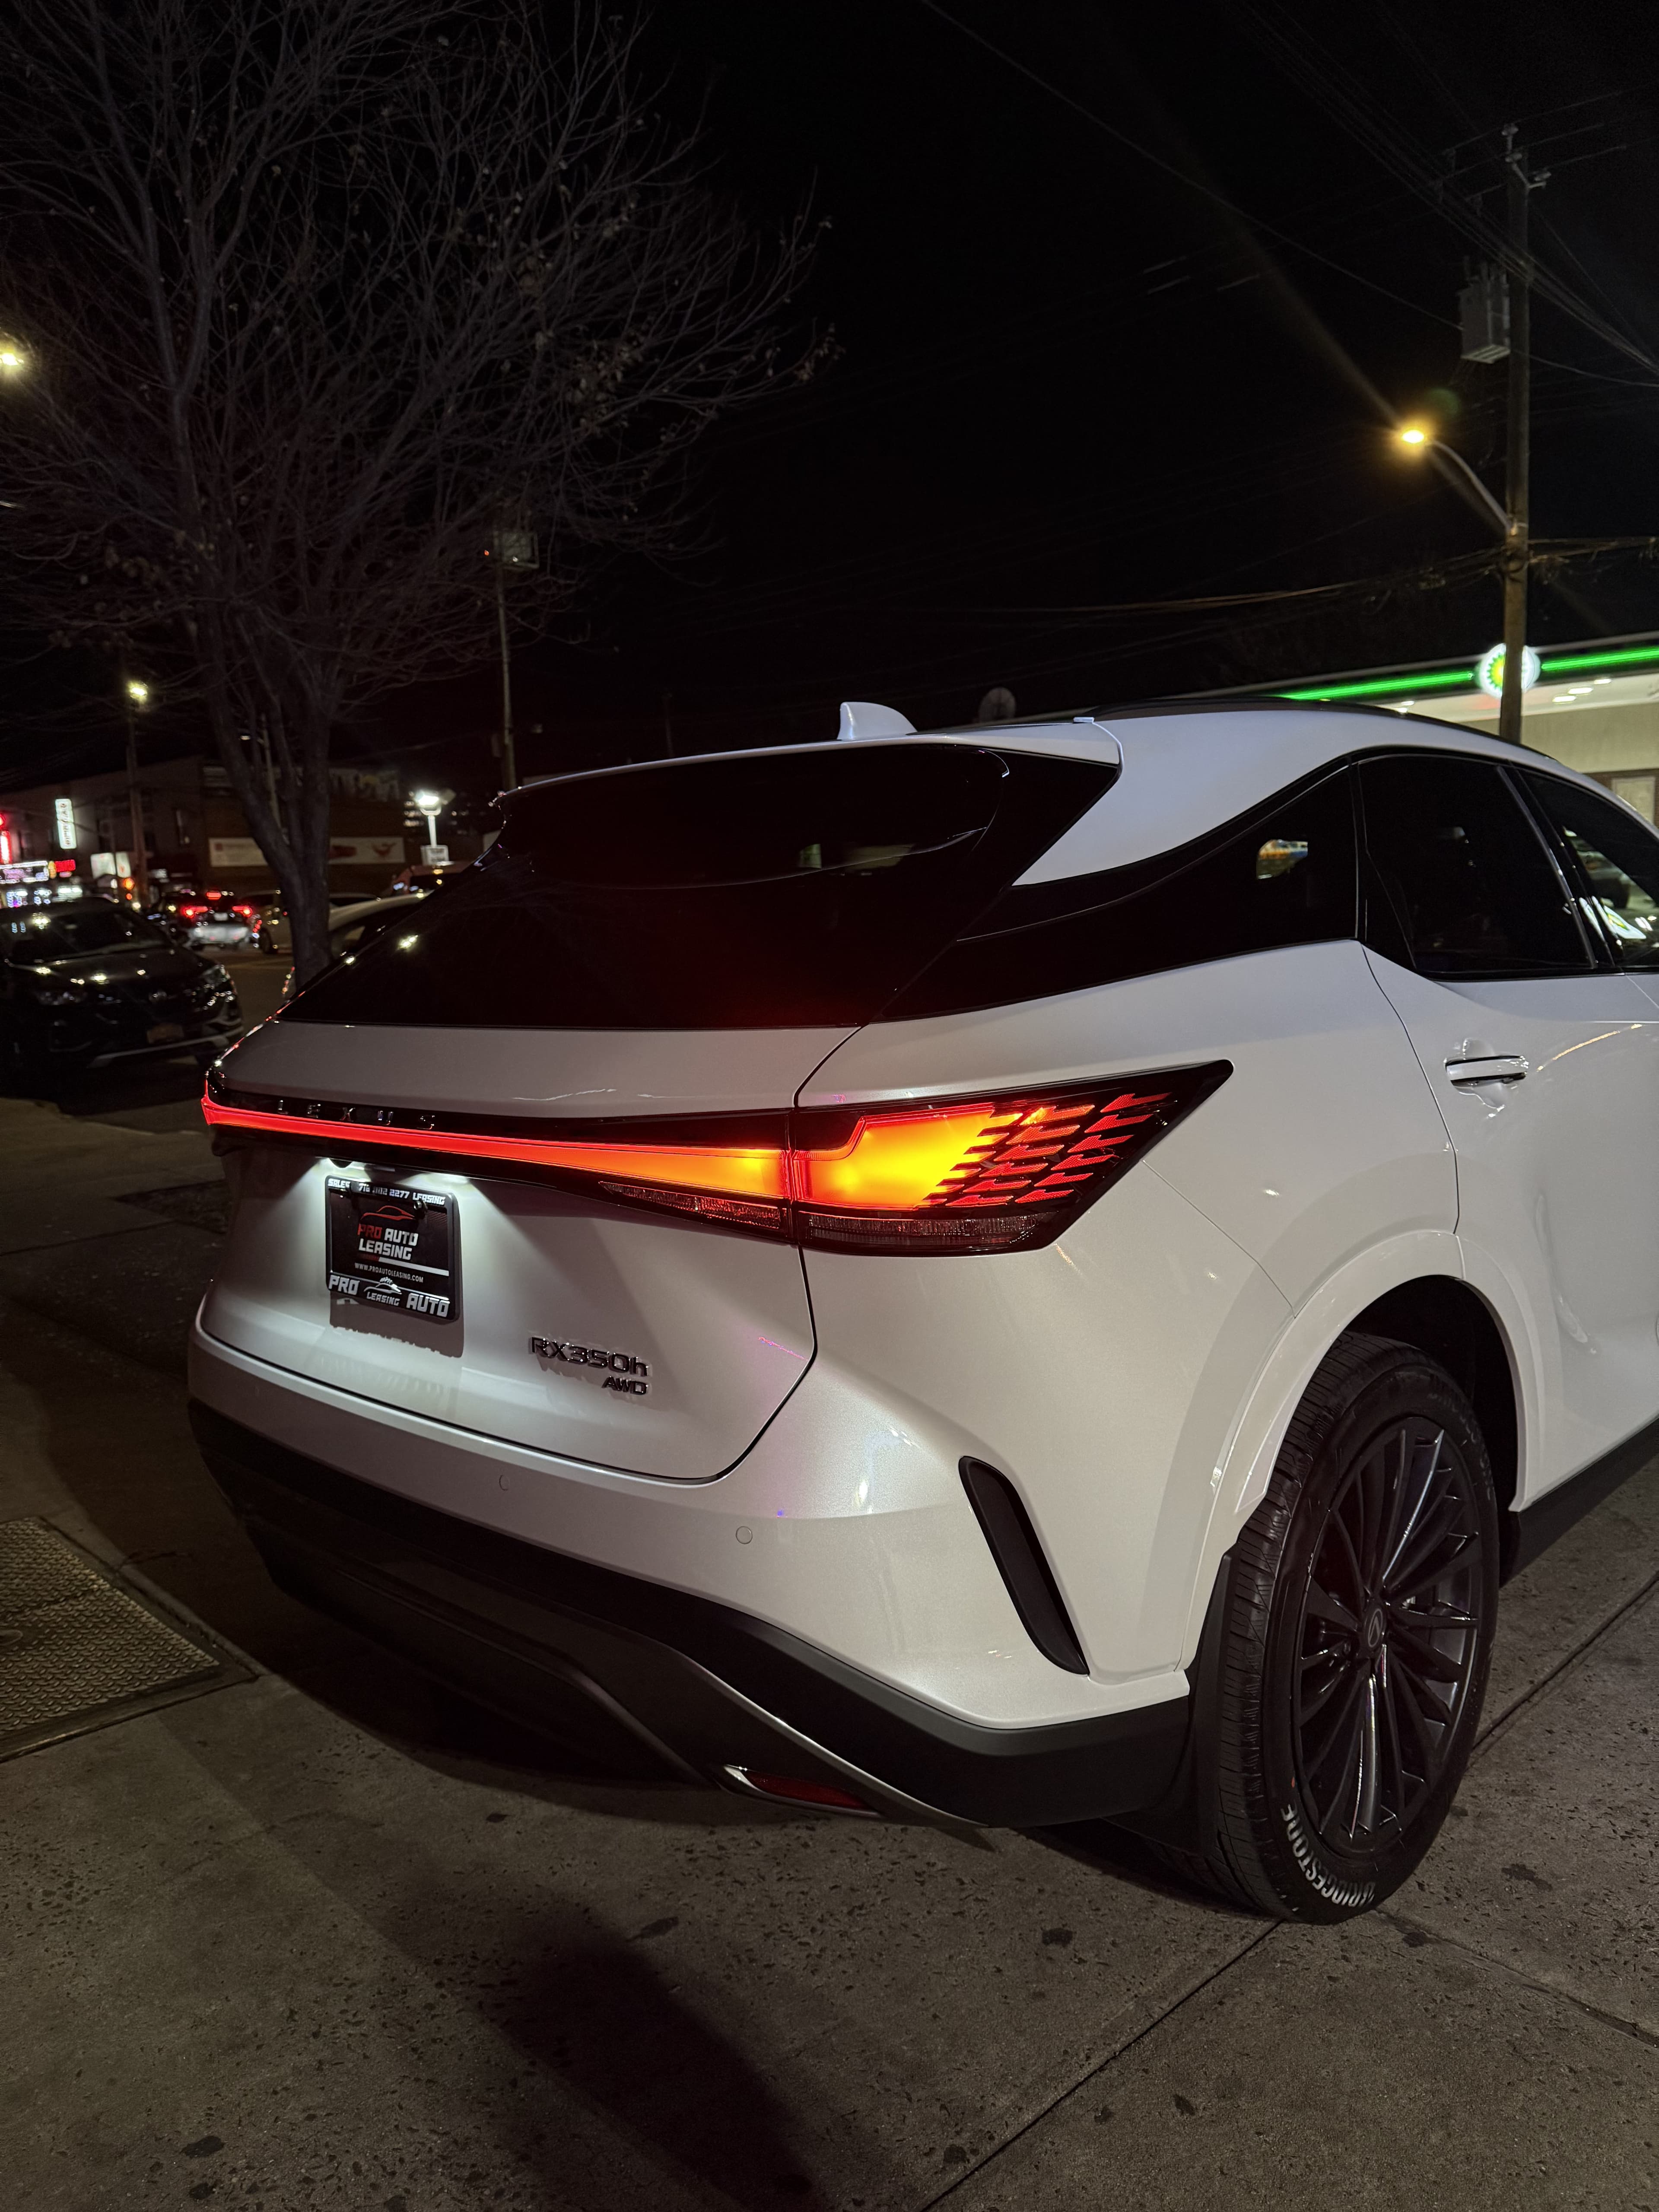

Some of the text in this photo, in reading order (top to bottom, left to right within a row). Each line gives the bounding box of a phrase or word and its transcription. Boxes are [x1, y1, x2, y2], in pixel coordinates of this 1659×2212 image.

[389, 1189, 410, 1199] 2277
[413, 1192, 446, 1206] LEASING
[357, 1224, 419, 1246] PRO AUTO
[359, 1238, 412, 1260] LEASING
[355, 1262, 424, 1283] WWW.PROAUTOLEASING.COM
[328, 1274, 450, 1317] PRO AUTO
[366, 1291, 400, 1306] LEASING
[601, 1376, 648, 1395] AWD
[1280, 1803, 1376, 1907] BRIDGESTONE
